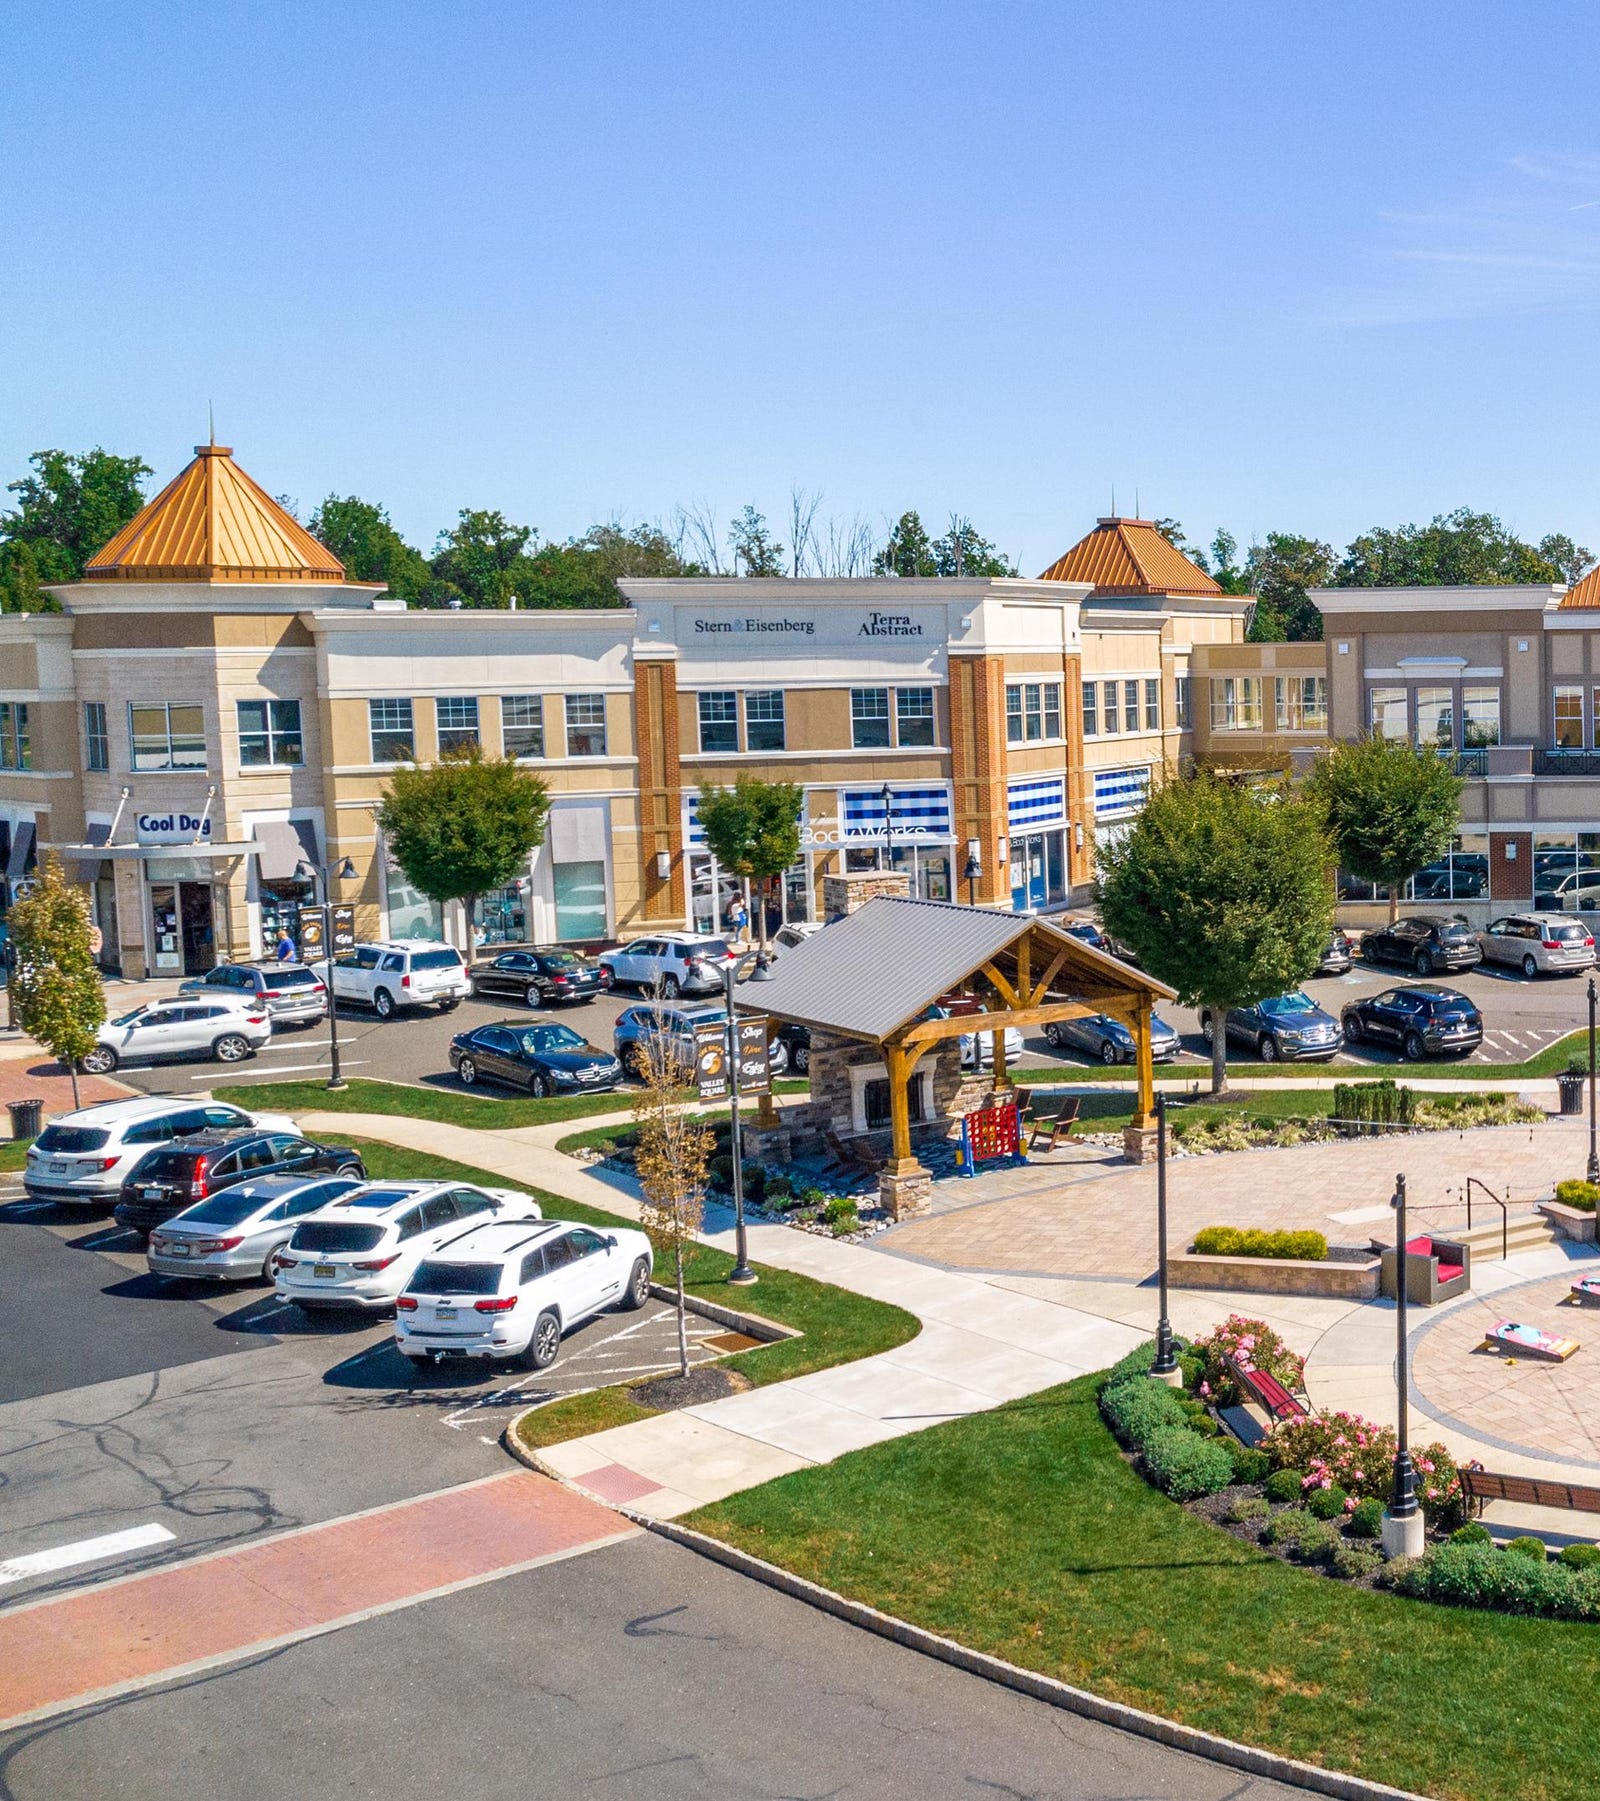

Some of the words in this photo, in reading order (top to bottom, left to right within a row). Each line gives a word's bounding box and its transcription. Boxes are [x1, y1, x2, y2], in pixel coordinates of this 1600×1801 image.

[869, 612, 911, 625] Terra
[858, 623, 923, 636] Abstract
[139, 814, 175, 832] Cool
[179, 814, 211, 835] Dog
[741, 1026, 763, 1039] Shop
[742, 1061, 765, 1076] Enjoy
[700, 1078, 725, 1088] VALLEY
[700, 1086, 726, 1097] SQUARE
